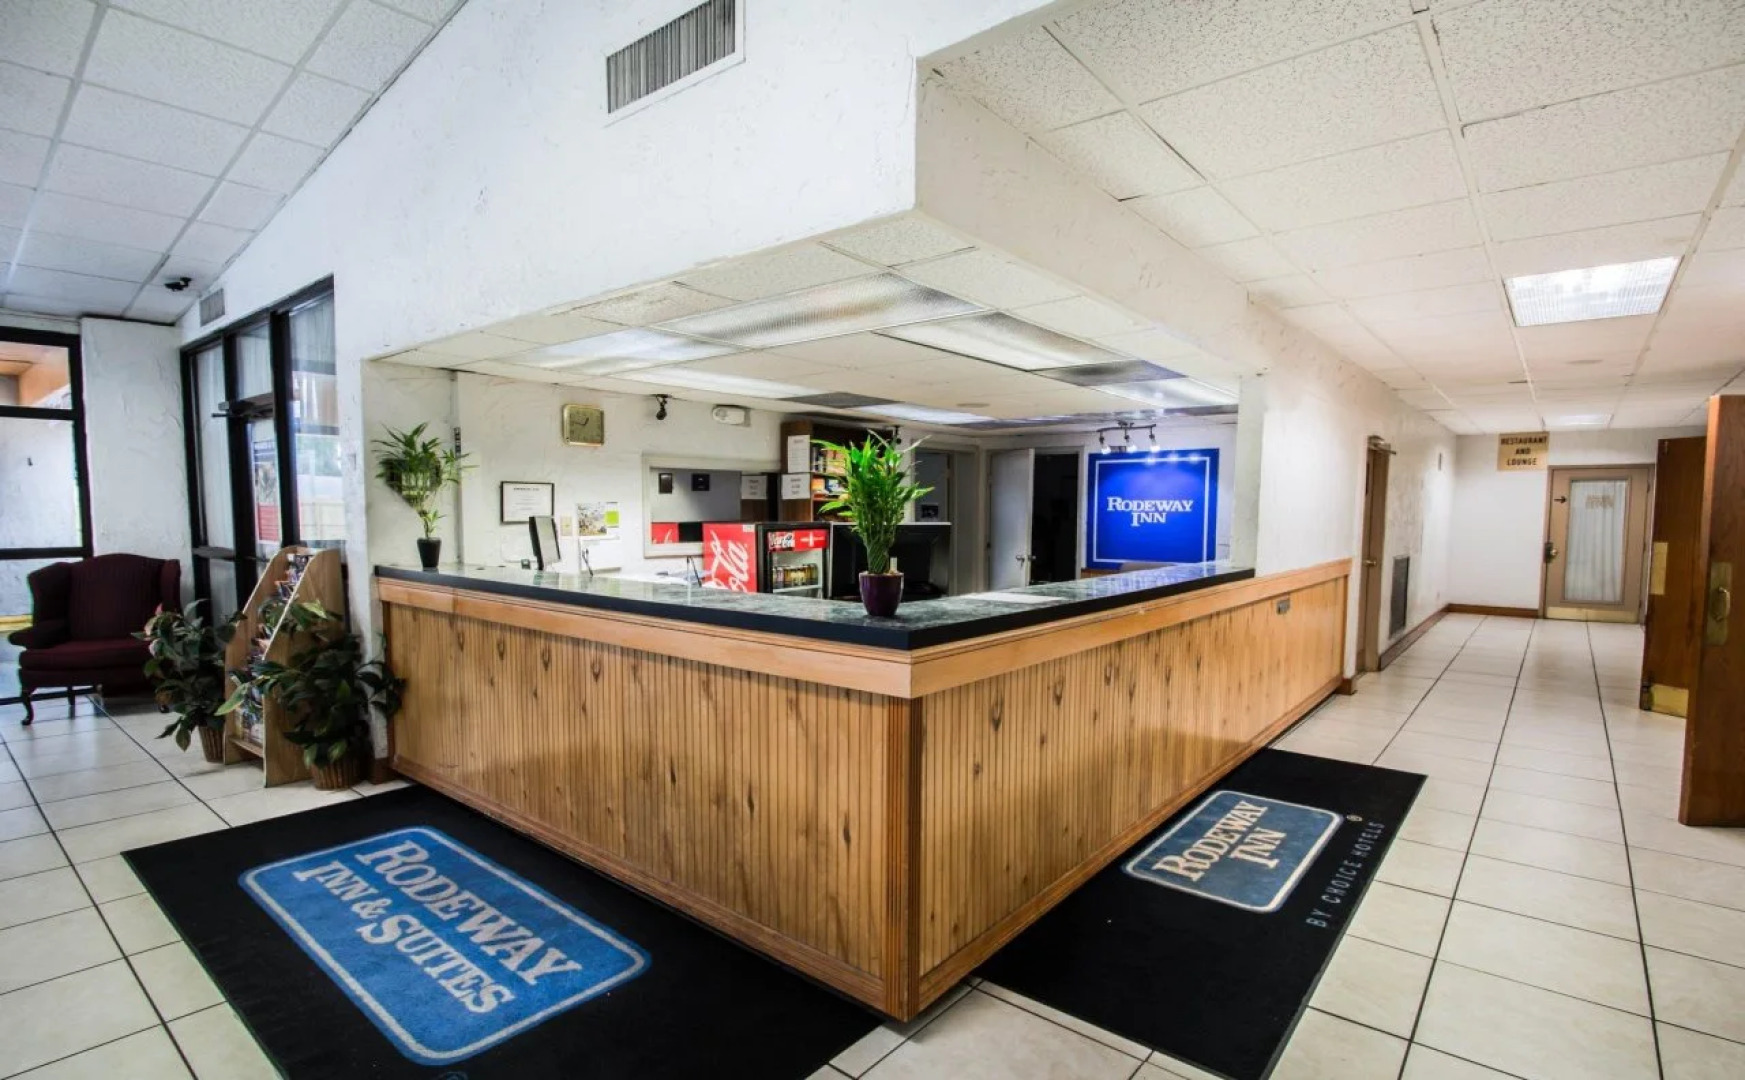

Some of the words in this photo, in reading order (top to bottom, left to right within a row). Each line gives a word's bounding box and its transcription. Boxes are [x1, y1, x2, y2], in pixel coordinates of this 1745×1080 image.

[1500, 436, 1548, 446] RESTAURANT
[1515, 447, 1532, 455] AND
[1506, 458, 1538, 466] LOUNGE
[1106, 496, 1194, 512] RODEWAY
[1130, 512, 1167, 527] INN
[1151, 800, 1268, 882] RODEWAY
[1229, 826, 1287, 869] INN
[1305, 908, 1332, 928] BY
[1321, 860, 1363, 904] CHOICE
[1350, 821, 1386, 858] HOTELS
[354, 839, 583, 986] RODEWAY
[292, 860, 380, 901] INN
[355, 914, 516, 1014] SUITES
